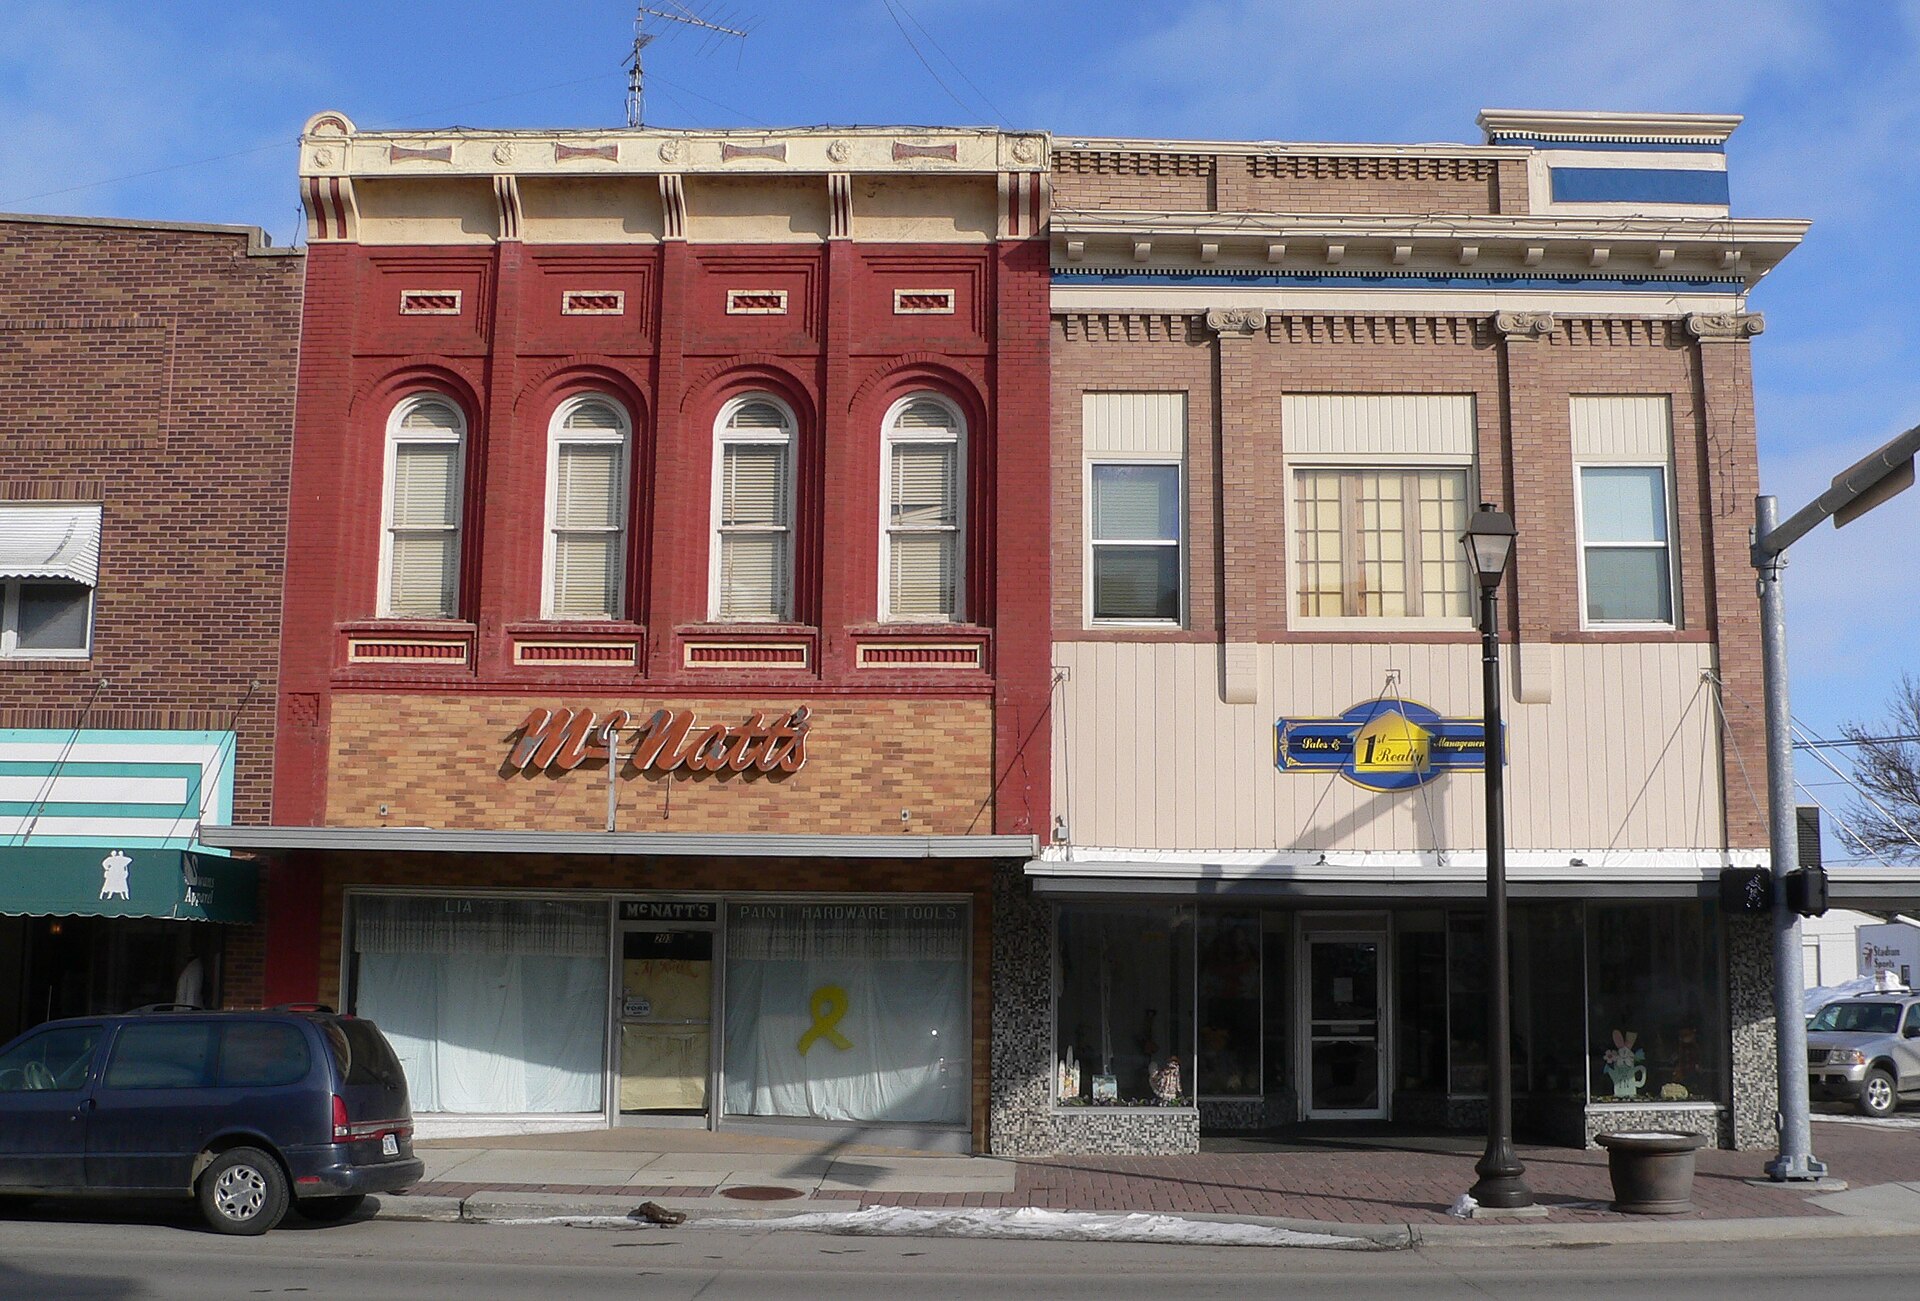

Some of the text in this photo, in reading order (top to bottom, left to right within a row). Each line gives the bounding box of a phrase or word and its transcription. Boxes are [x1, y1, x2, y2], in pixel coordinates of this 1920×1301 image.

[1302, 737, 1328, 750] Sales
[1433, 737, 1486, 752] Managemen
[1376, 748, 1424, 767] Realty
[740, 906, 957, 920] PAINT HARDWARE TOOLS
